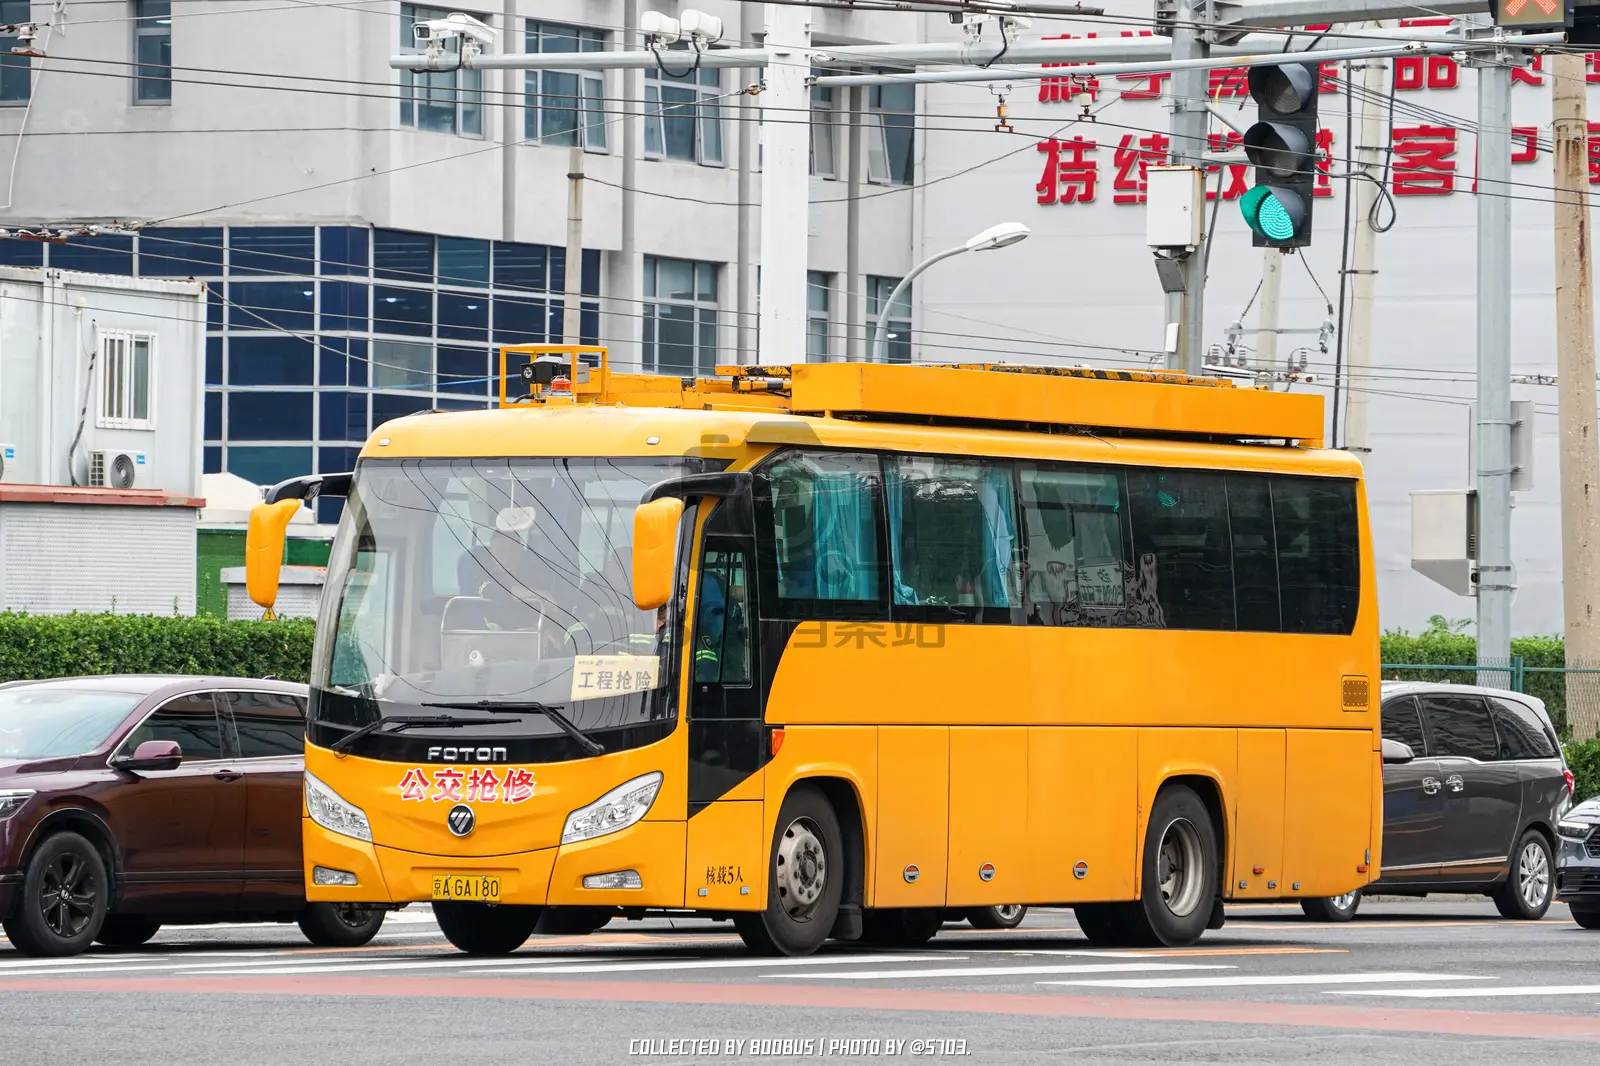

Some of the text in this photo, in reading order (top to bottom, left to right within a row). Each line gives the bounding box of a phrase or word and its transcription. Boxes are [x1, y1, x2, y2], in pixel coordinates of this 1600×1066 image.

[577, 670, 652, 690] 工程抢险
[427, 747, 507, 761] FOTON
[399, 768, 536, 804] 公交抢修
[706, 865, 743, 885] 核载5人
